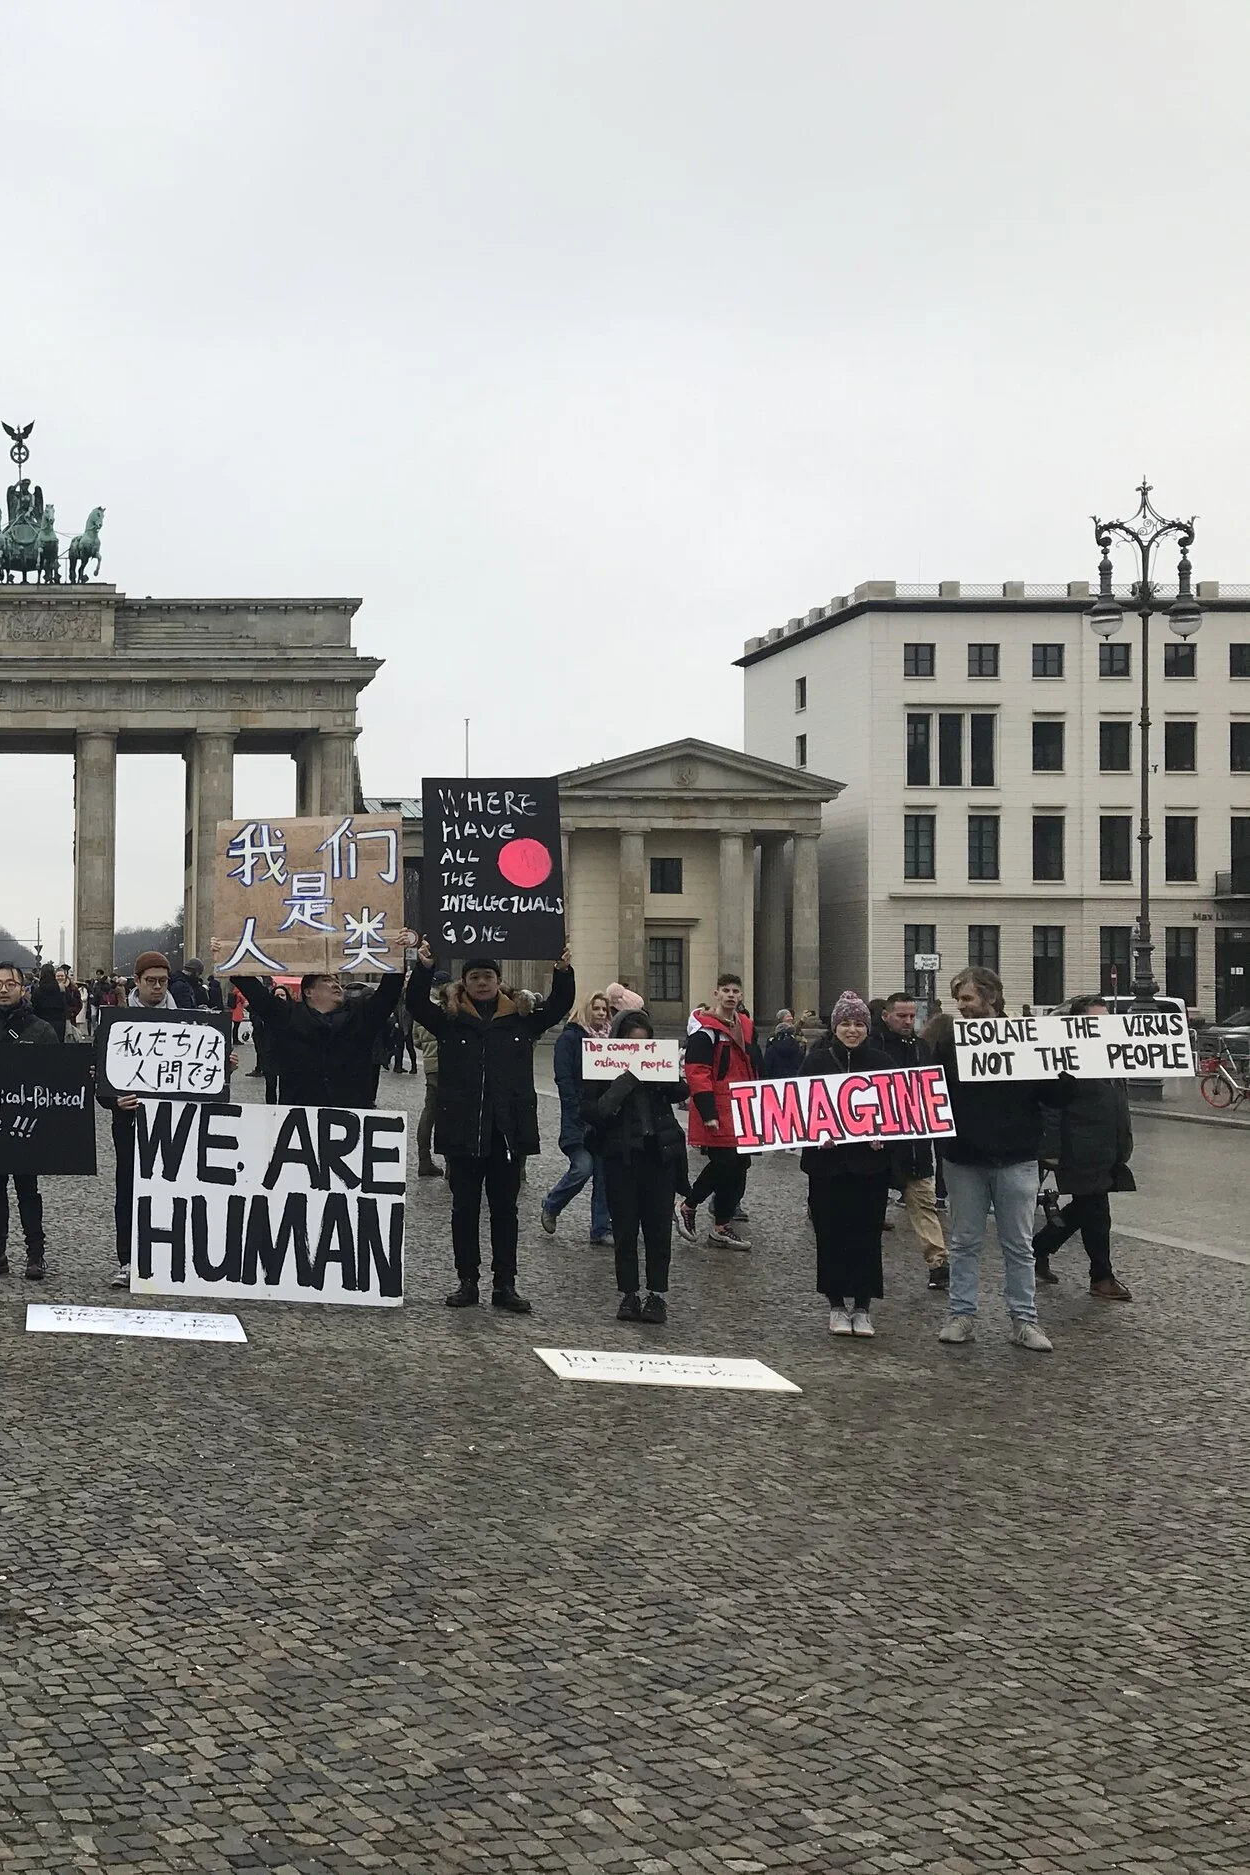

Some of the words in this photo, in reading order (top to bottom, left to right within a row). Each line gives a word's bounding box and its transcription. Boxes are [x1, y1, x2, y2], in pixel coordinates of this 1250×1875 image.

[438, 789, 538, 817] WHERE
[441, 821, 515, 842] HAVE
[226, 817, 398, 887] 我们
[440, 848, 479, 864] ALL
[441, 871, 477, 887] THE
[278, 871, 338, 932] 是
[440, 894, 564, 914] INTELLECTUALS
[215, 907, 397, 972] 人类
[442, 921, 508, 944] GONE
[113, 1025, 222, 1061] 私たちは
[954, 1018, 1038, 1046] ISOLATE
[1061, 1016, 1101, 1039] THE
[1123, 1014, 1183, 1037] VIRUS
[583, 1041, 603, 1051] The
[644, 1041, 657, 1053] of
[971, 1051, 1015, 1076] NOT
[1034, 1046, 1080, 1071] THE
[1106, 1042, 1189, 1070] PEOPLE
[126, 1060, 222, 1090] 人間です
[594, 1057, 630, 1072] ordinary
[641, 1059, 673, 1072] people
[731, 1068, 953, 1146] IMAGINE
[261, 1107, 406, 1196] ARE
[137, 1192, 404, 1298] HUMAN
